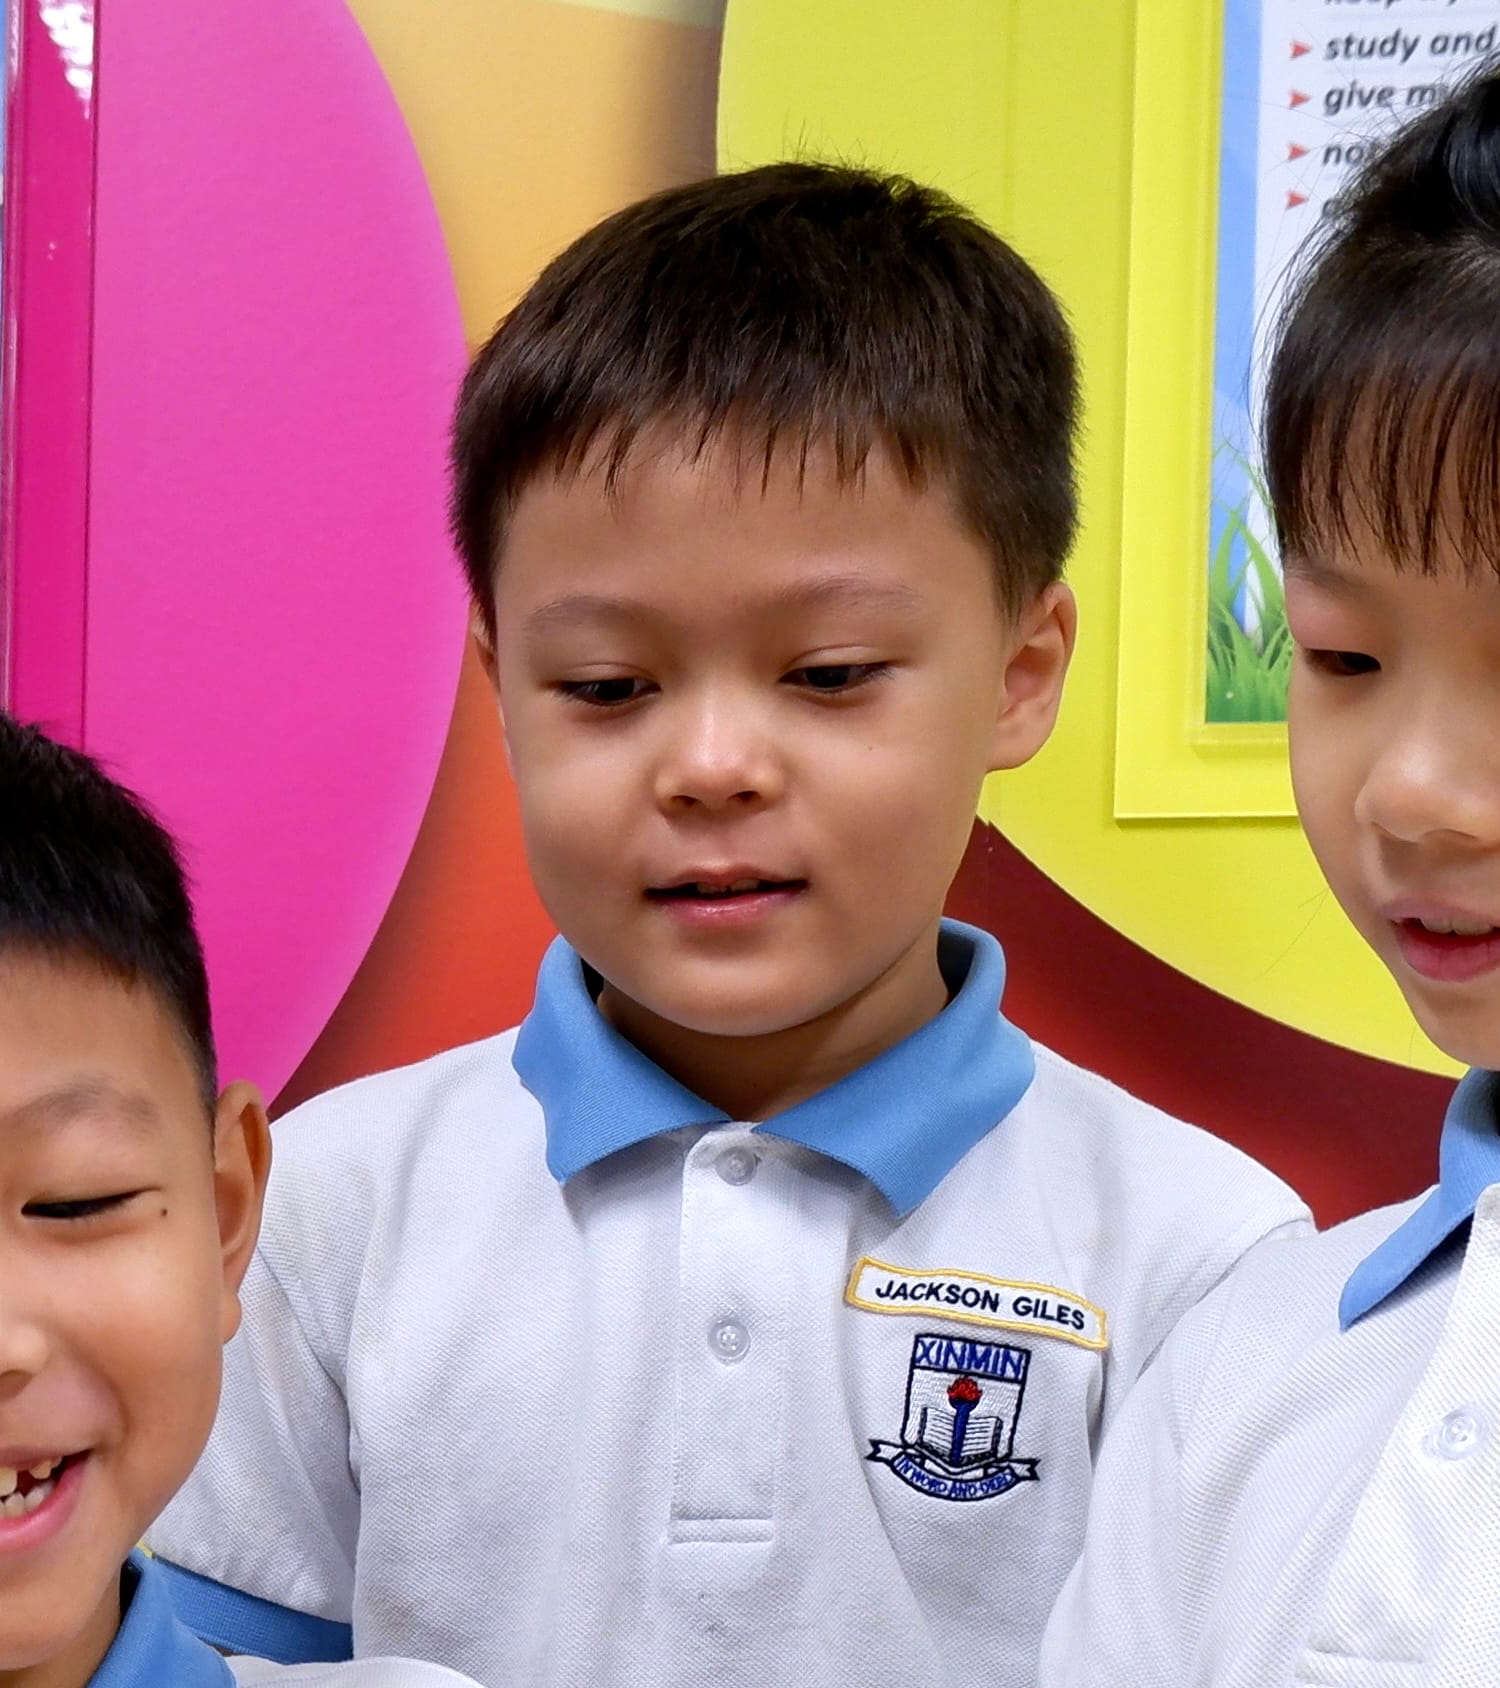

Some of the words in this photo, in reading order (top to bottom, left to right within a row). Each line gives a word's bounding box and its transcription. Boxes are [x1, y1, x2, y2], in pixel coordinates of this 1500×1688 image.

[1323, 28, 1421, 64] study
[1430, 24, 1497, 55] and
[1323, 80, 1394, 116] give
[876, 1279, 1000, 1313] JACKSON
[1012, 1296, 1086, 1331] GILES
[915, 1339, 1025, 1380] XINMIN
